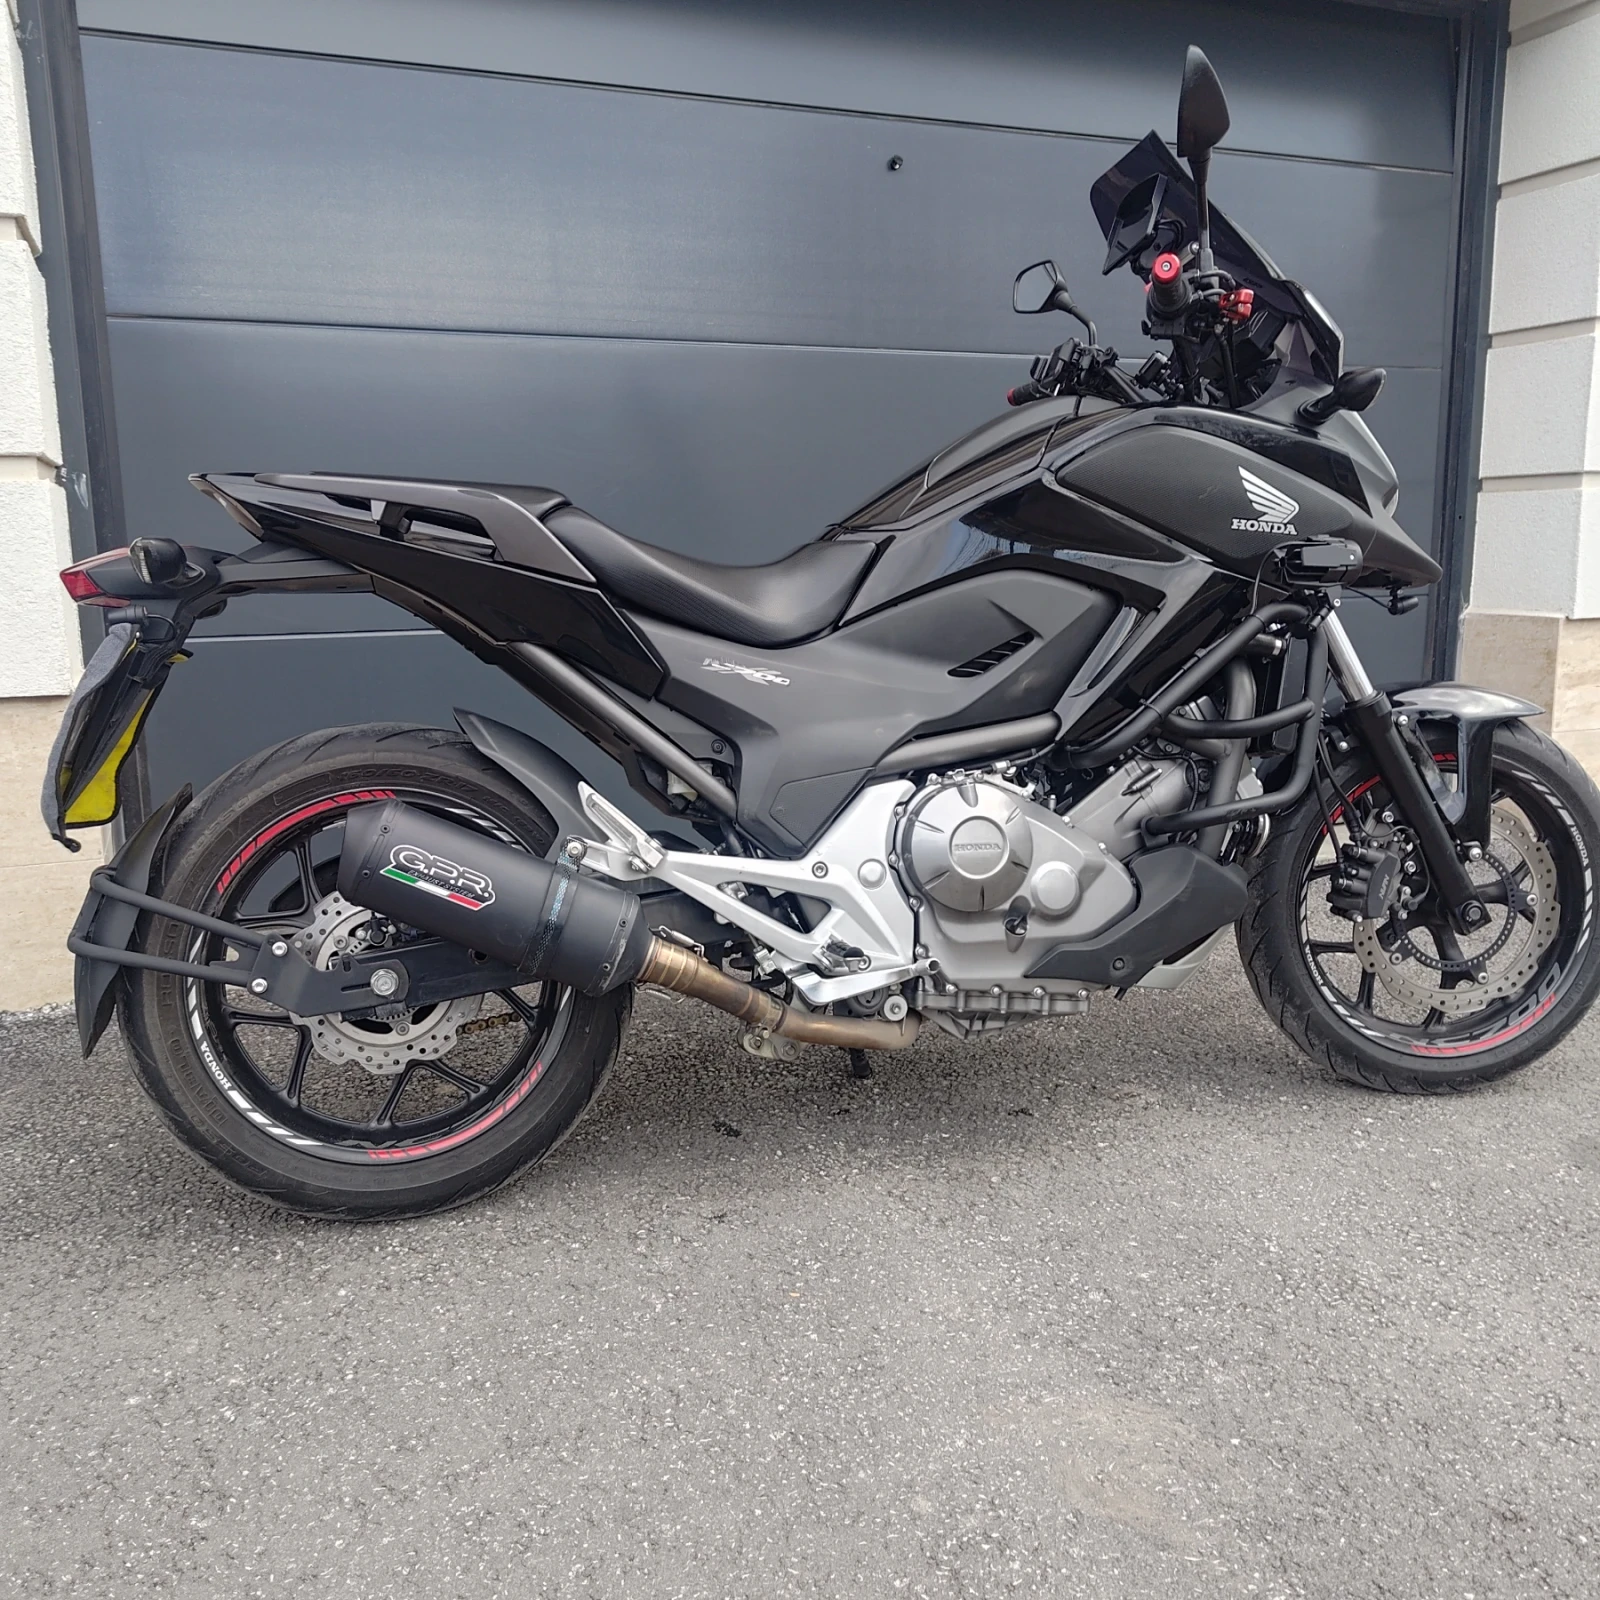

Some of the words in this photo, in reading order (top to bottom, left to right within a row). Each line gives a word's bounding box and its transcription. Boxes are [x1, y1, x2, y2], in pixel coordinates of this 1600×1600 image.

[1231, 518, 1298, 535] HONDA
[954, 843, 1002, 852] HONDA
[1570, 825, 1589, 867] HONDA
[407, 869, 442, 887] EXHAUST
[443, 884, 475, 899] SYSTEM
[1305, 944, 1324, 986] HONDA
[200, 1040, 232, 1090] HONDA
